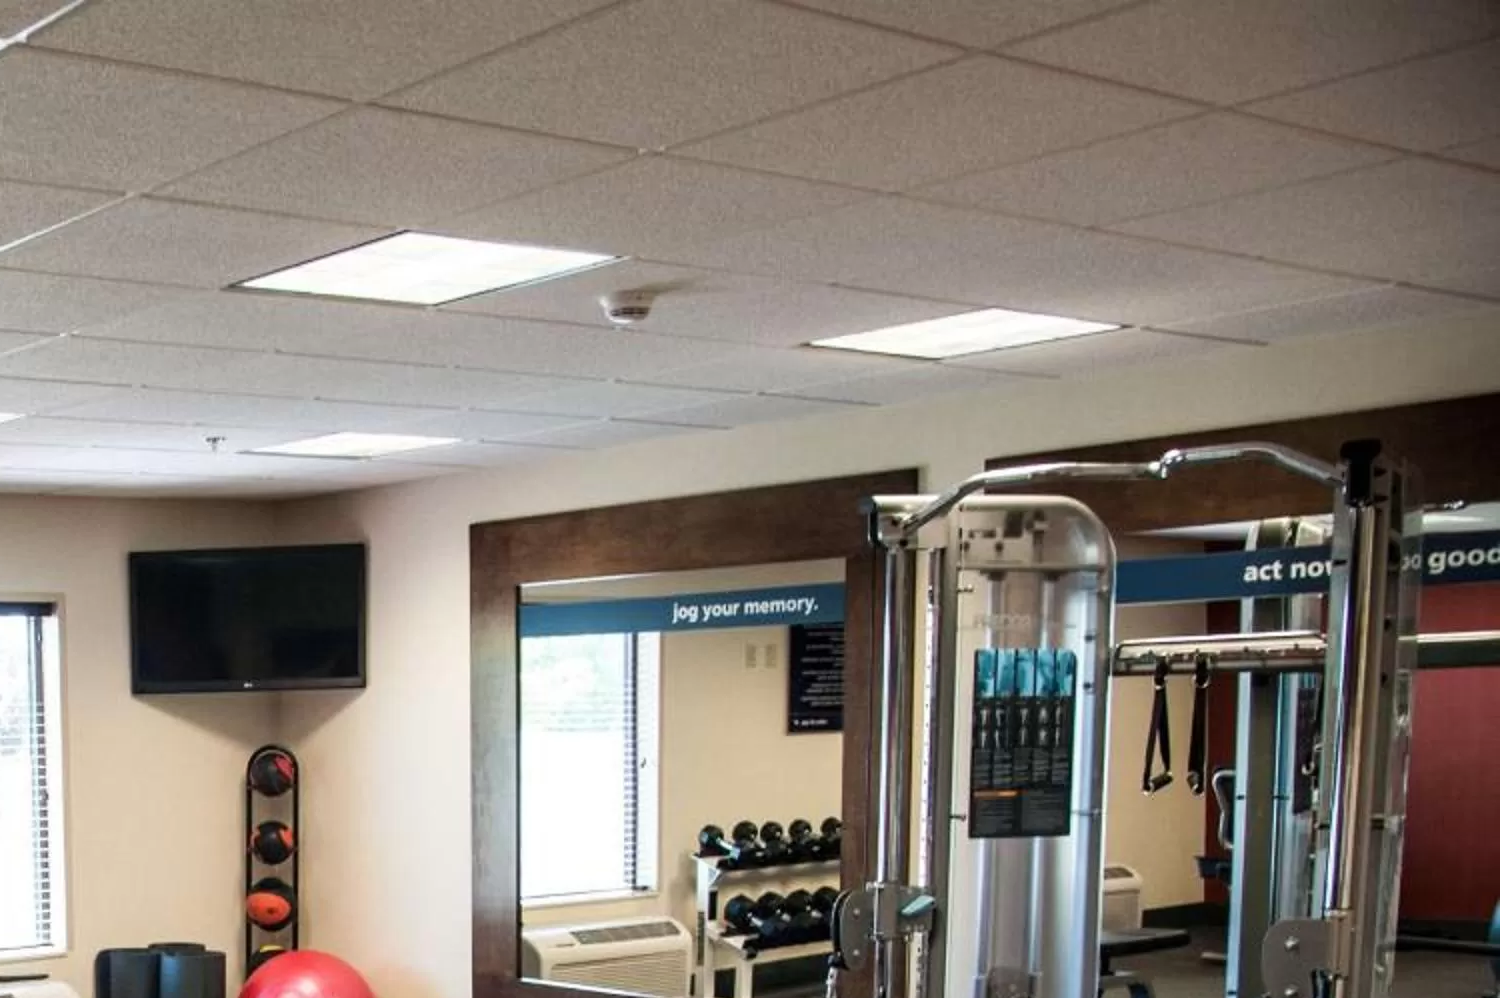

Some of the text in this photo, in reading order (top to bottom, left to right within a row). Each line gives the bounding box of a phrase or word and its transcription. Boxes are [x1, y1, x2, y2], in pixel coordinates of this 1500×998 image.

[1243, 560, 1284, 583] act
[671, 597, 819, 624] jog your memory.
